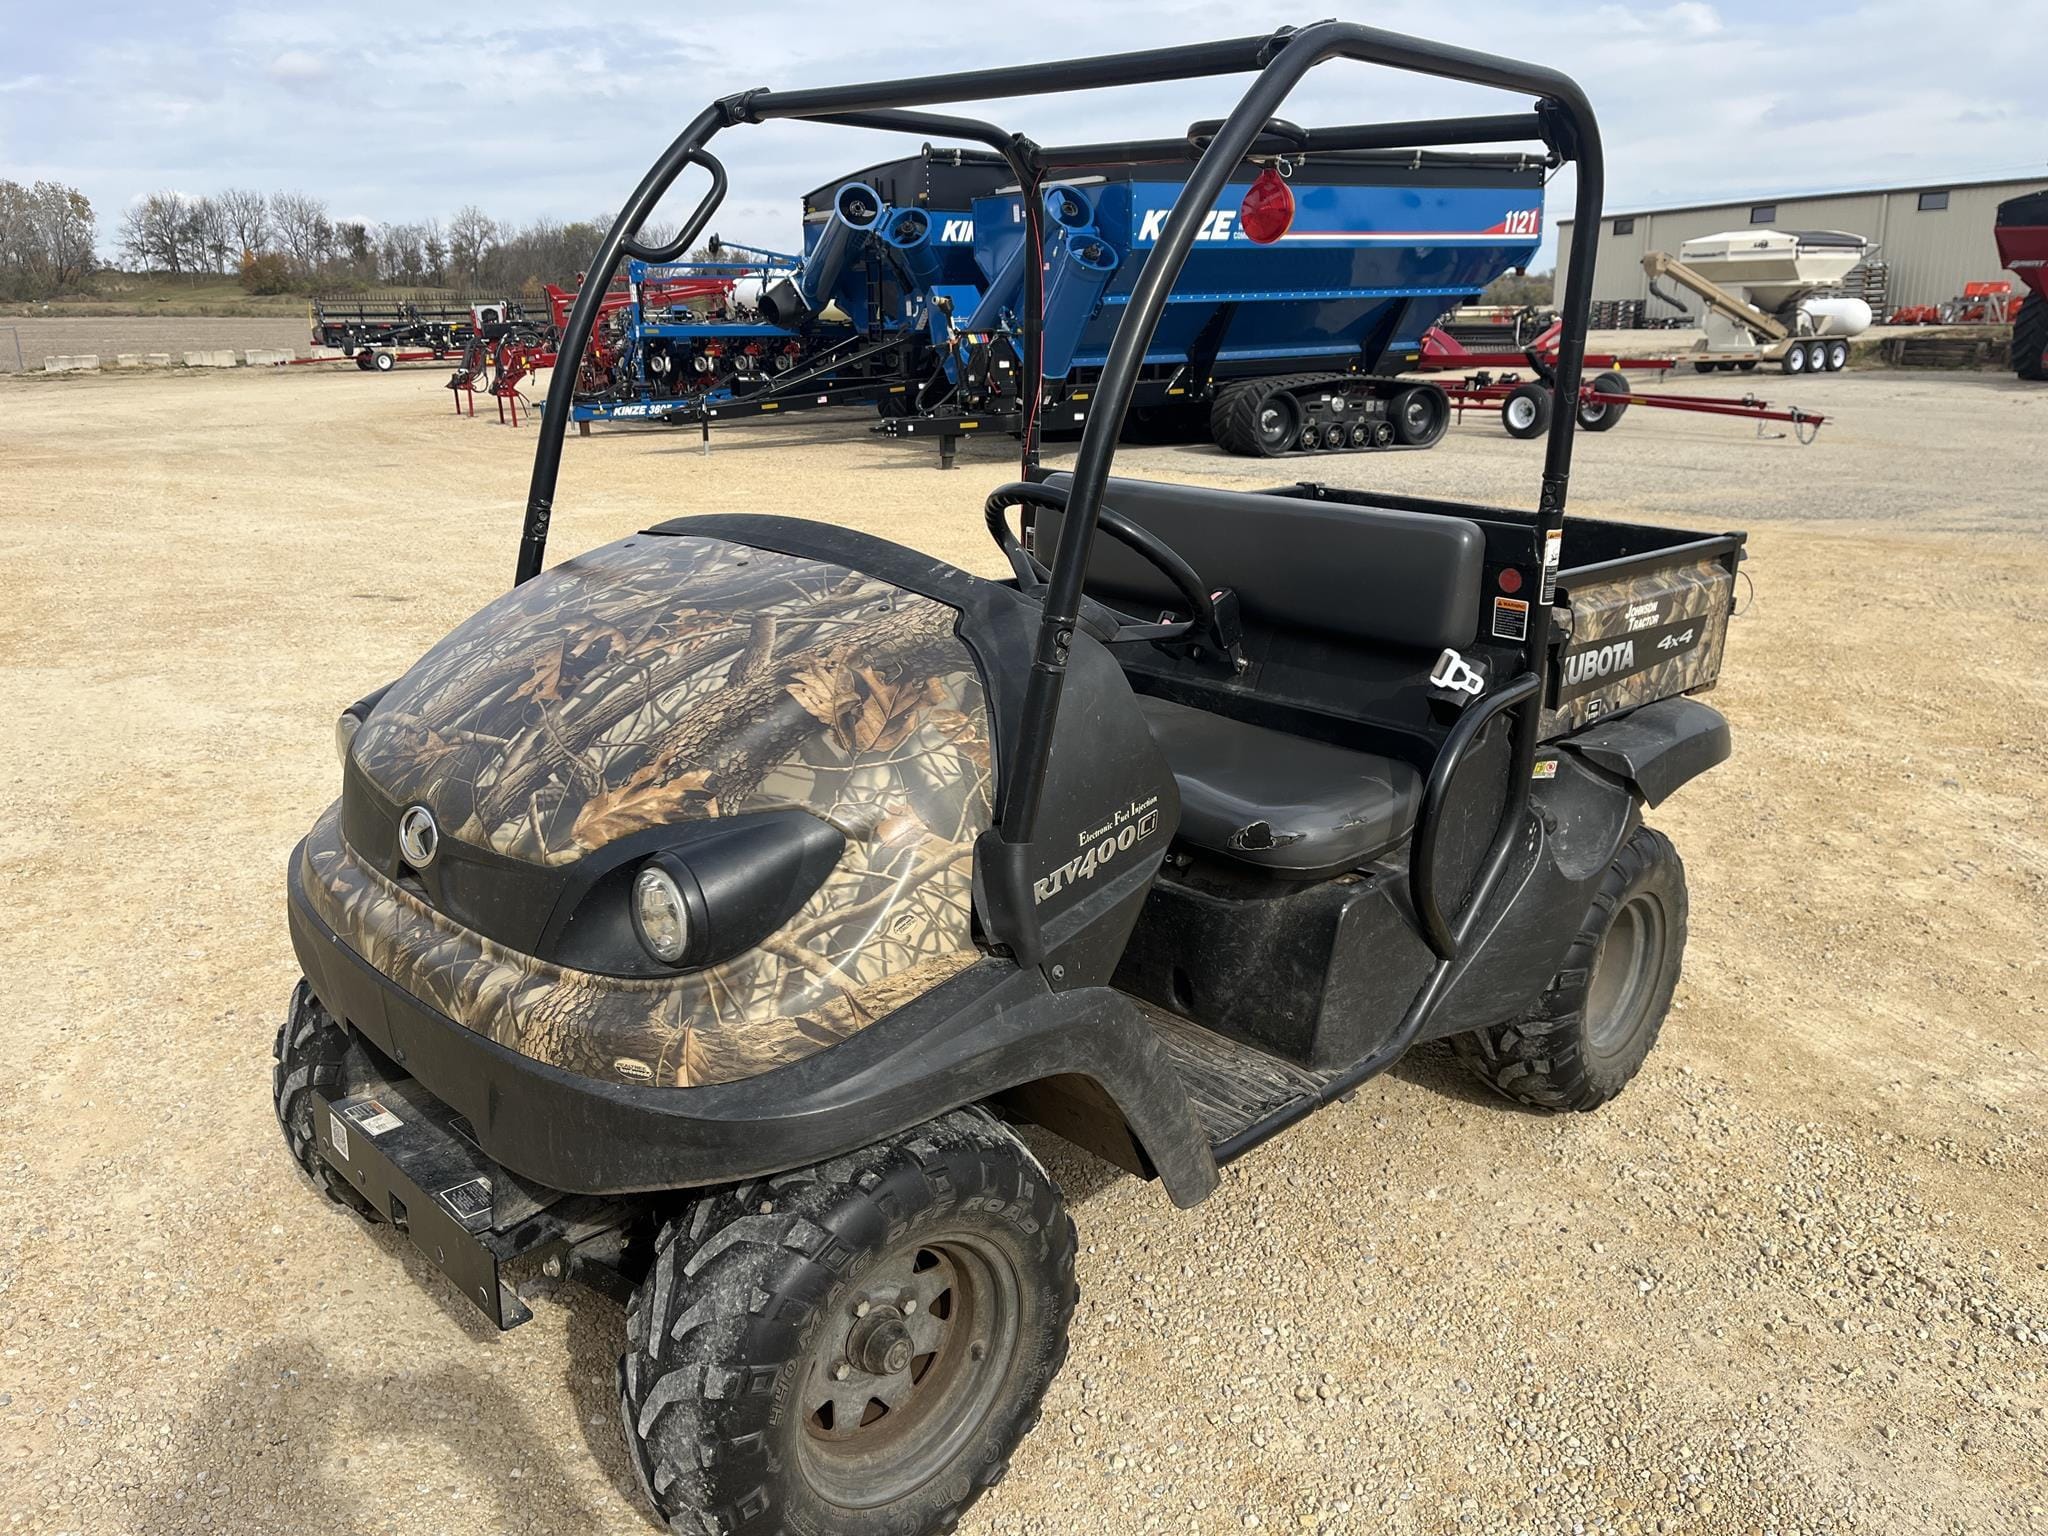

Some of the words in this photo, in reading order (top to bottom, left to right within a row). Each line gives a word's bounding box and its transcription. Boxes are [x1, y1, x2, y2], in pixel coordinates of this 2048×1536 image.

[941, 220, 974, 242] KIN
[1138, 209, 1237, 241] KZE
[1505, 210, 1537, 234] 1121
[613, 405, 647, 417] KINZE
[648, 404, 672, 415] 36
[1624, 601, 1658, 619] JOHNSON
[1627, 614, 1659, 632] TRACTOR
[1657, 628, 1694, 650] 4x4
[1078, 822, 1113, 847] Electronic
[1114, 810, 1130, 827] Fuel
[1131, 796, 1158, 816] Injection
[769, 1359, 797, 1427] 440
[962, 1196, 1040, 1235] ROAD
